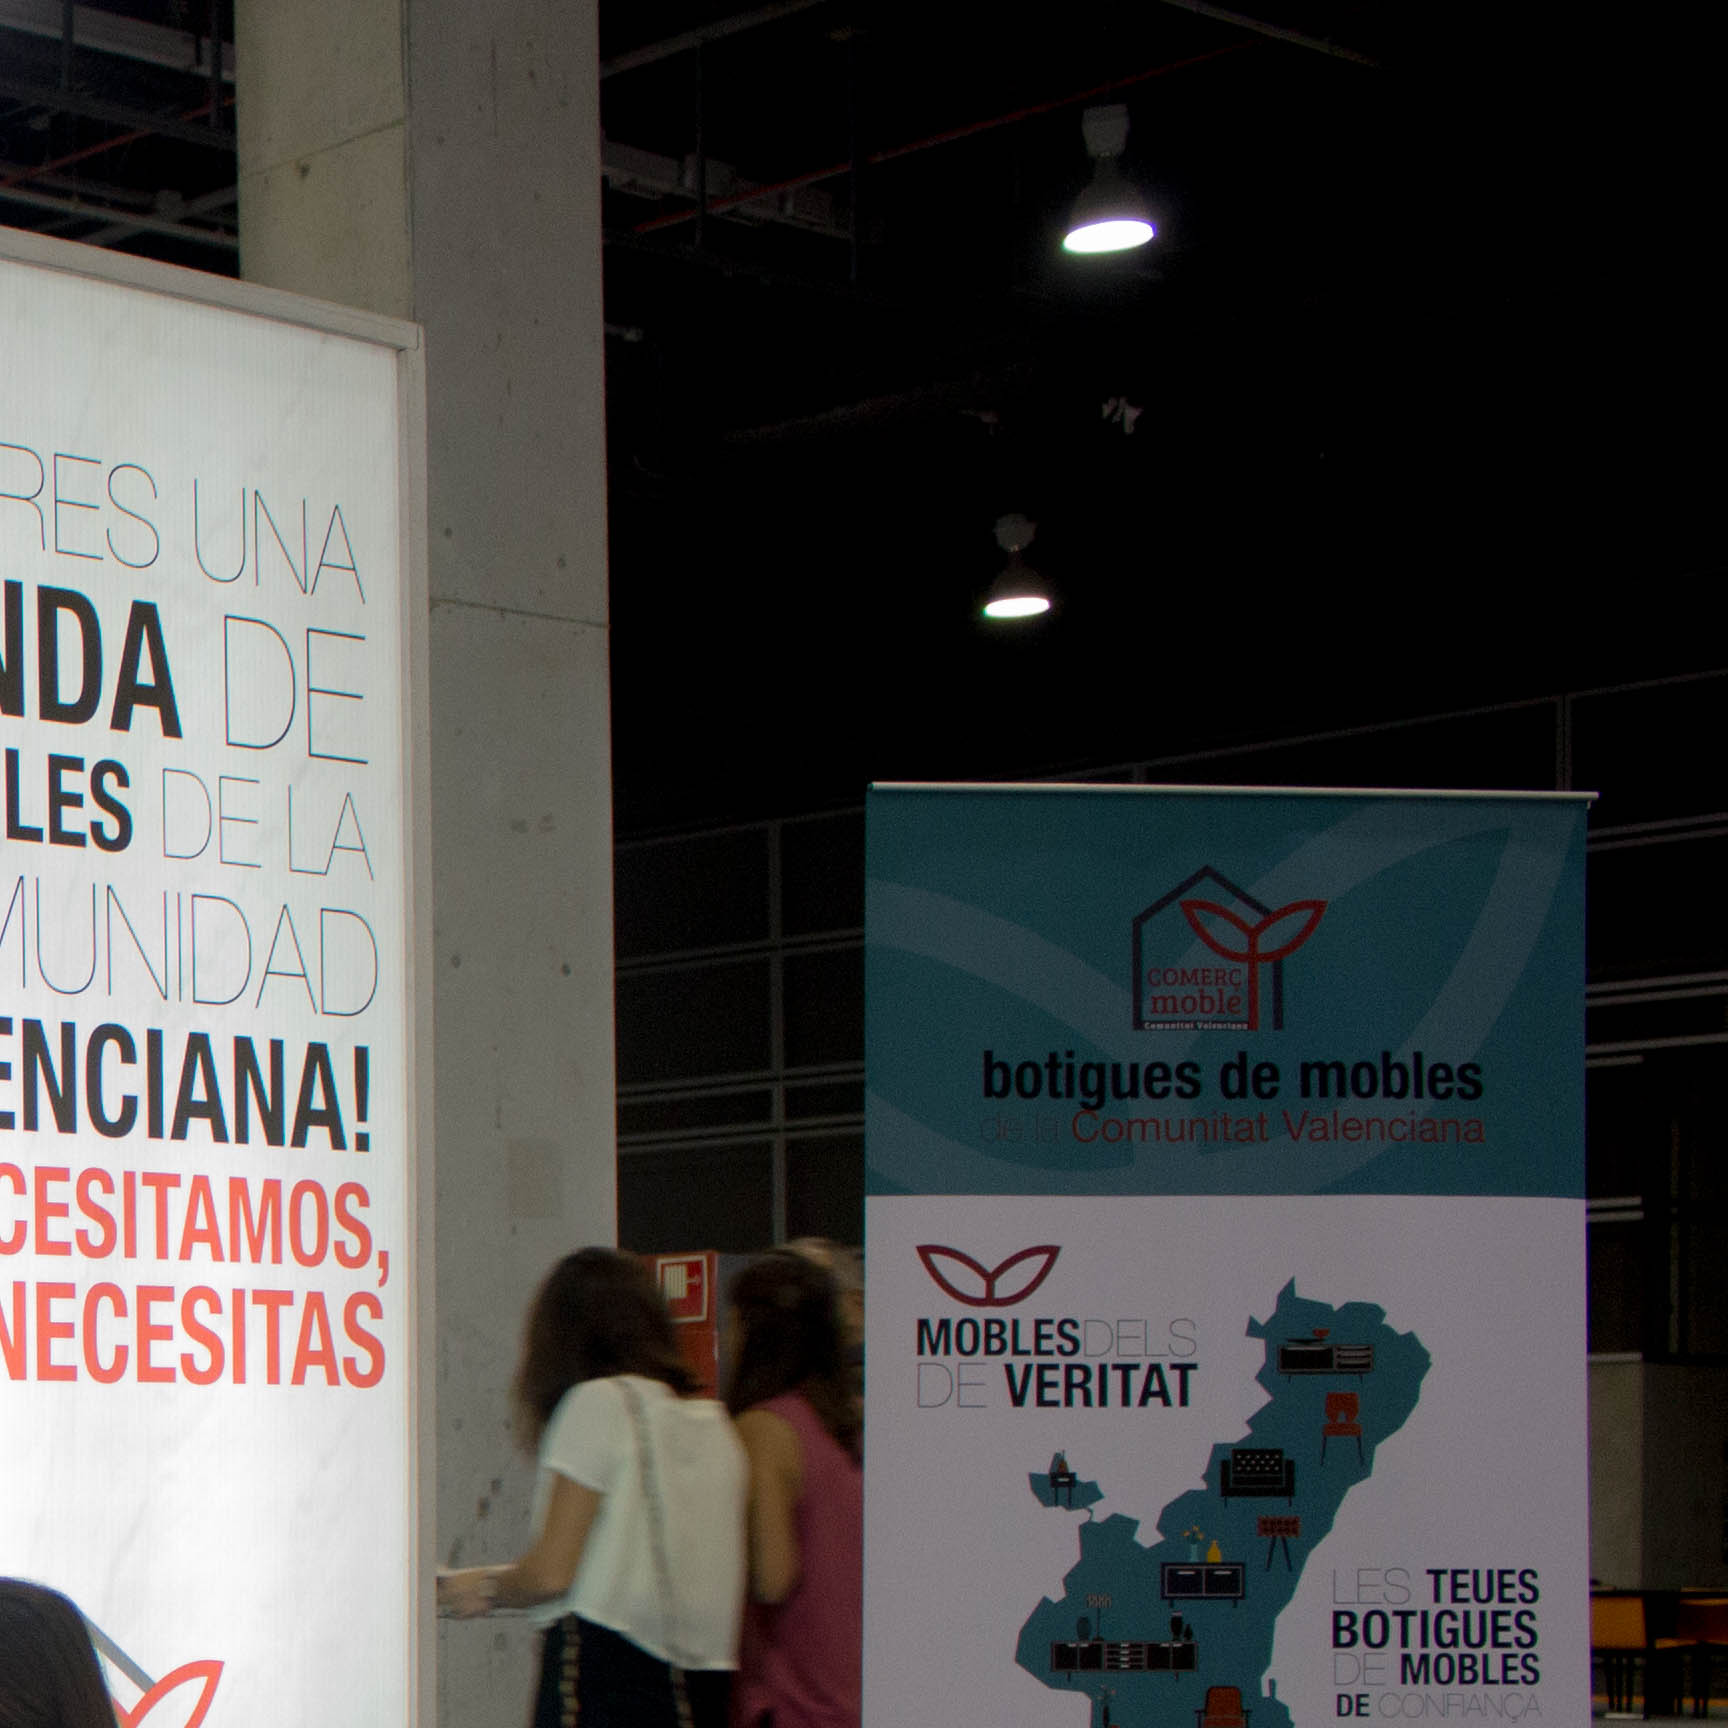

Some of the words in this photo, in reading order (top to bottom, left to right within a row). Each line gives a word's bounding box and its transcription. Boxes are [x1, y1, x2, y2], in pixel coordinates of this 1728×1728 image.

[193, 477, 366, 605] UNA
[224, 613, 369, 765] DE
[162, 767, 263, 868] DE
[288, 784, 375, 881] LA
[1147, 967, 1243, 992] COMERÇ
[1150, 988, 1242, 1016] moble
[982, 1049, 1203, 1112] botigues
[1220, 1050, 1281, 1100] de
[1300, 1050, 1484, 1102] mobles
[1071, 1109, 1270, 1144] Comunitat
[1282, 1110, 1487, 1145] Valenciana
[916, 1362, 988, 1408] DE
[1004, 1363, 1199, 1408] VERITAT
[1332, 1567, 1412, 1605] LES
[1426, 1568, 1540, 1604] TEUES
[1332, 1610, 1539, 1649] BOTIGUES
[1333, 1652, 1386, 1687] DE
[1400, 1653, 1541, 1685] MOBLES
[1336, 1693, 1370, 1718] DE
[1377, 1692, 1542, 1723] CONFIANÇA
